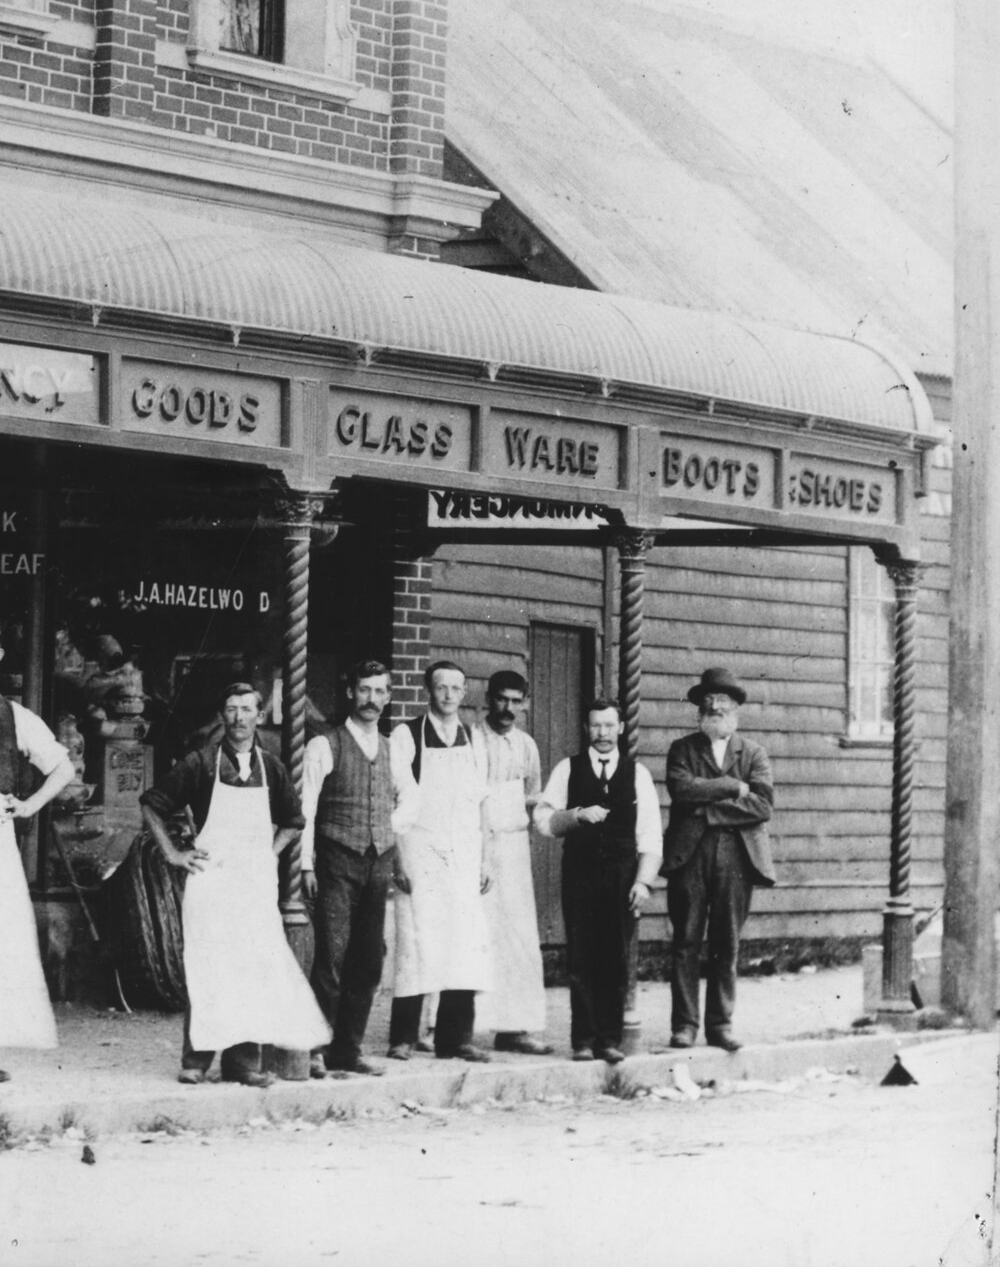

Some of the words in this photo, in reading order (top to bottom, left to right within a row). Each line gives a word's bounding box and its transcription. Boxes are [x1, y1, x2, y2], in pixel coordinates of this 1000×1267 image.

[131, 378, 260, 433] GOODS
[336, 404, 452, 459] GLASS
[503, 426, 600, 476] WARE
[663, 447, 760, 498] BOOTS
